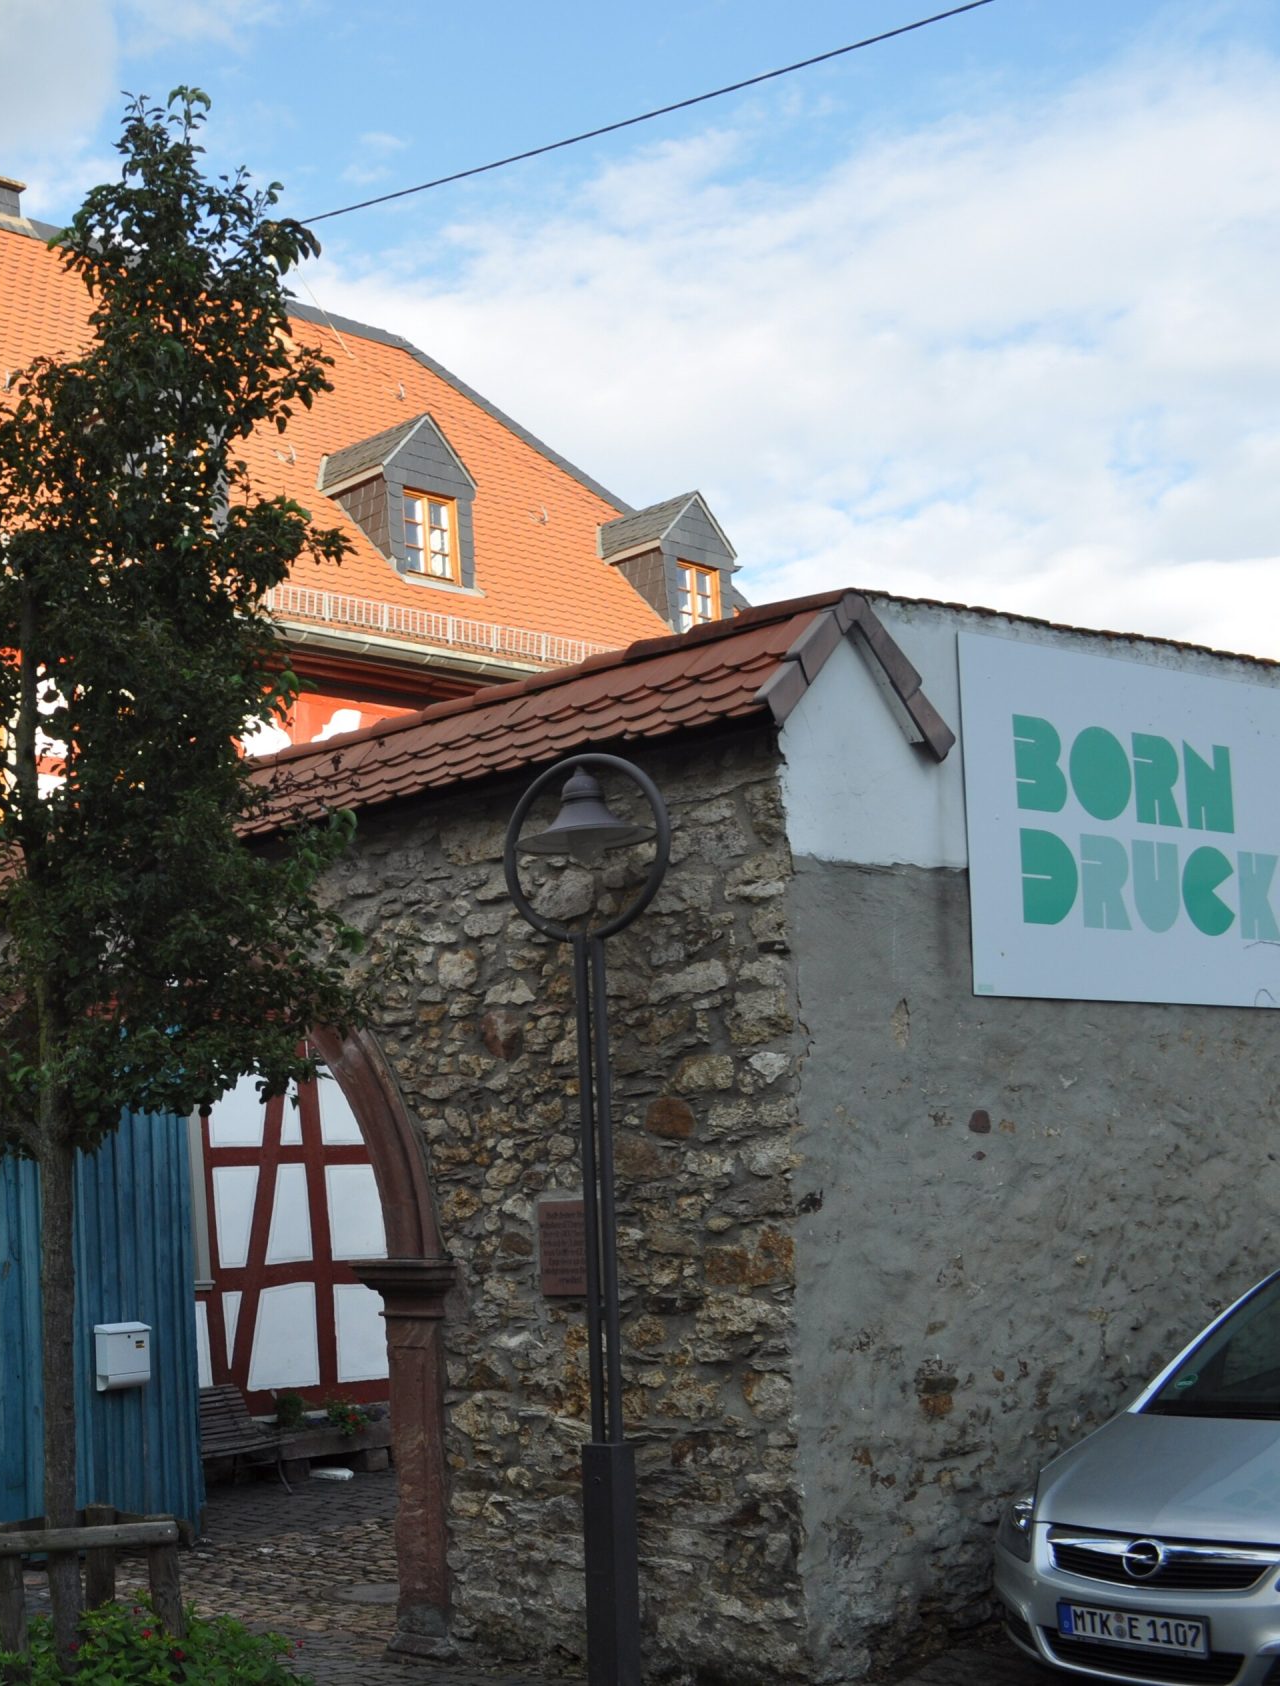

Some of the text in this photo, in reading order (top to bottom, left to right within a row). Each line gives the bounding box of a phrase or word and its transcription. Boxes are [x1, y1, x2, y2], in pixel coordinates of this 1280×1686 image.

[1012, 713, 1235, 834] BORN
[1019, 827, 1280, 942] DRUCK
[1072, 1608, 1202, 1648] MTK E 1107
